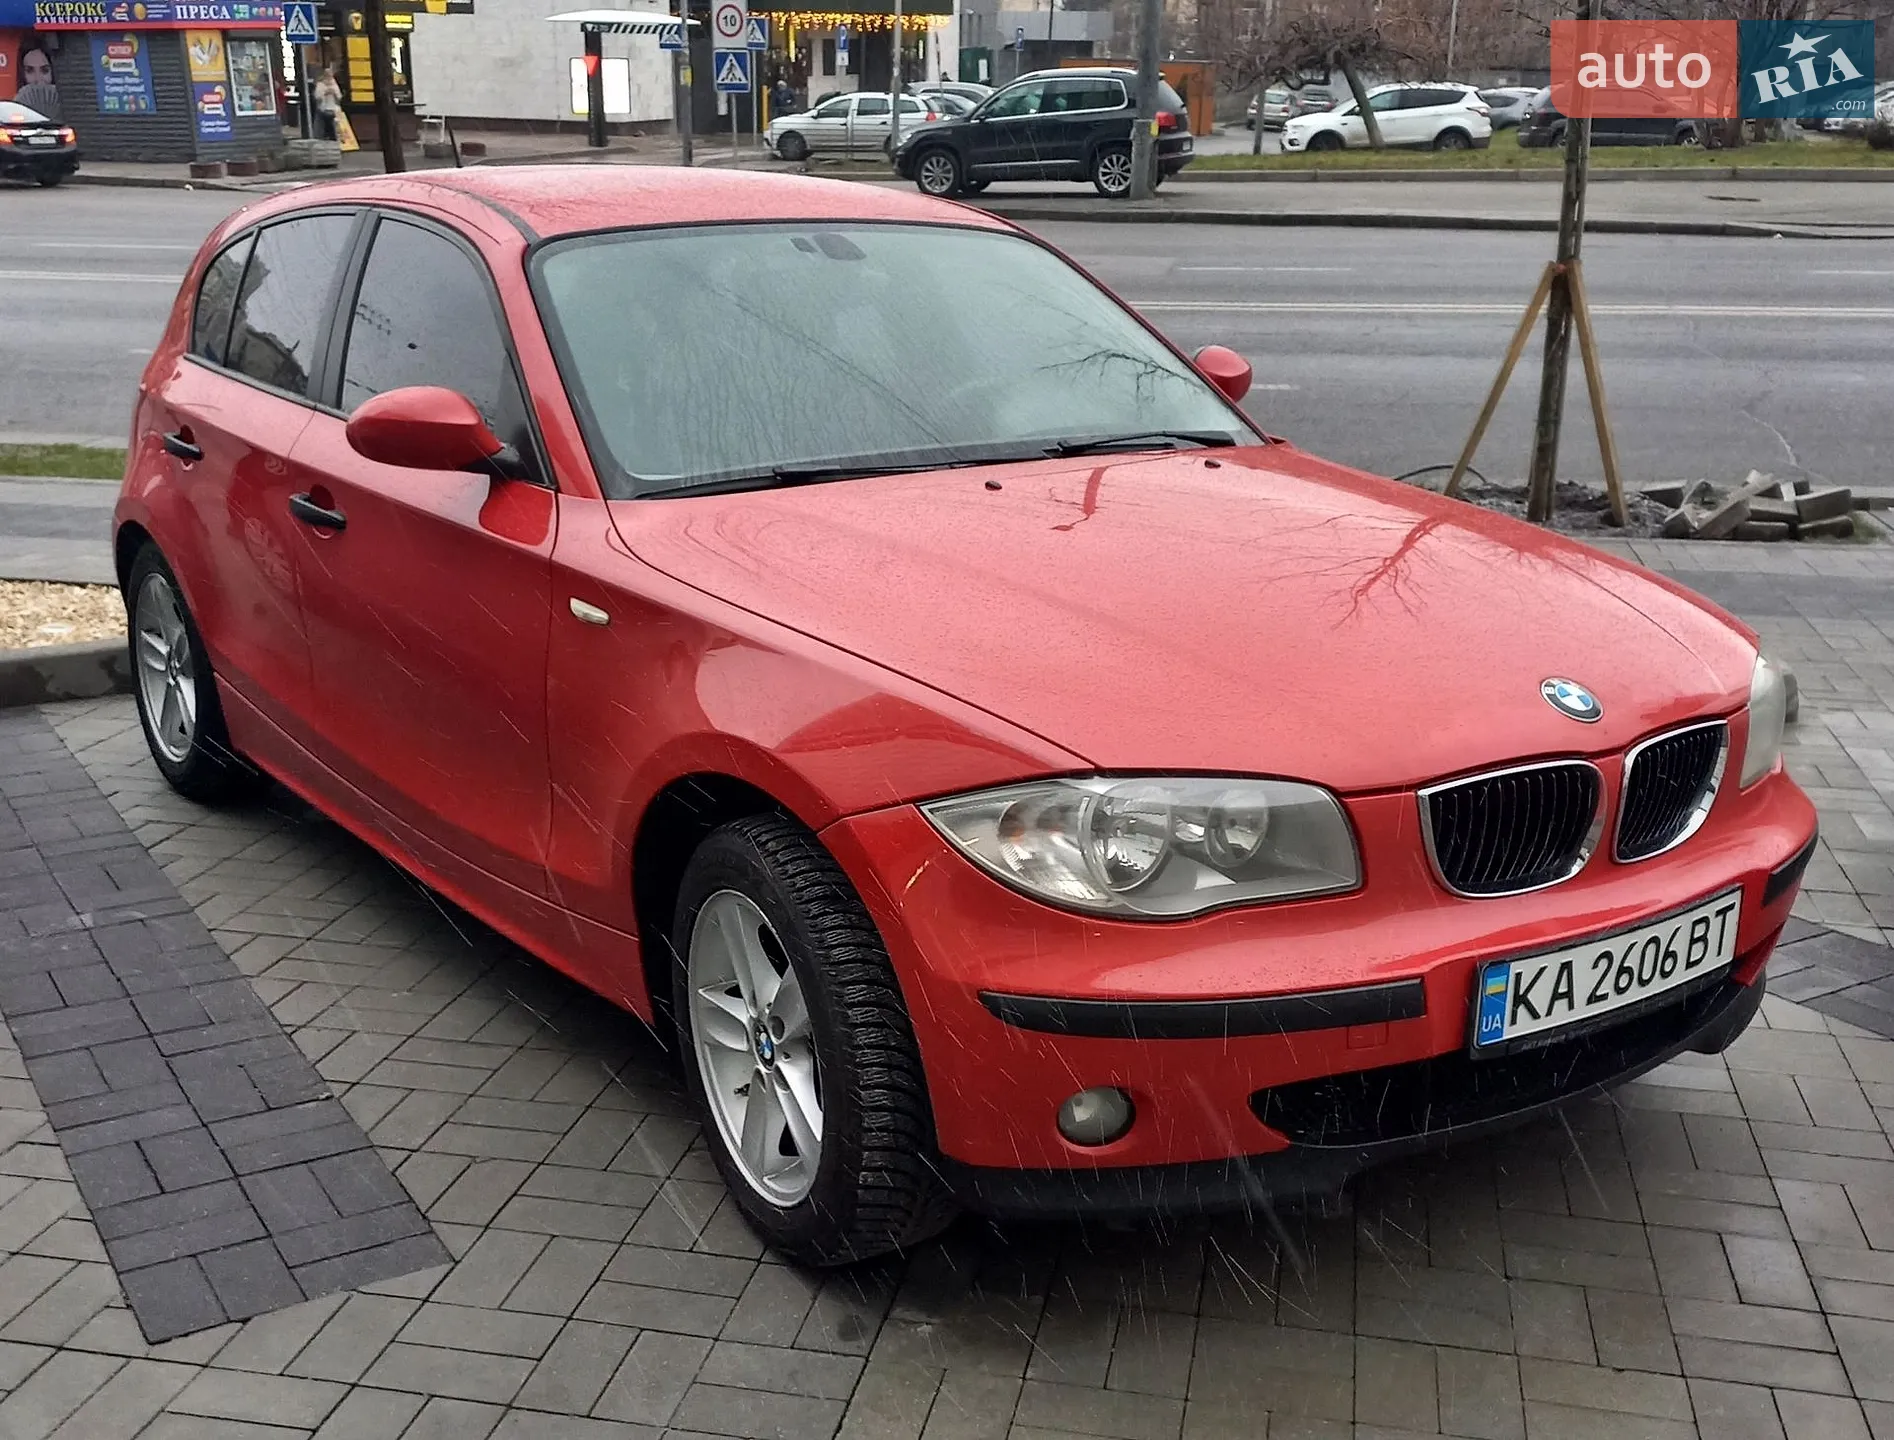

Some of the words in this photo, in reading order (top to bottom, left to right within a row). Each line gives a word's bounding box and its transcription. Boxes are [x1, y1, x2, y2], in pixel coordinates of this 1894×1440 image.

[35, 2, 108, 16] КСЕРОКС
[175, 5, 231, 20] ПРЕСА
[722, 14, 736, 27] 10
[1509, 960, 1576, 1027] KA
[1586, 923, 1682, 1007] 2606
[1685, 901, 1736, 971] BT
[1482, 1013, 1502, 1033] UA
